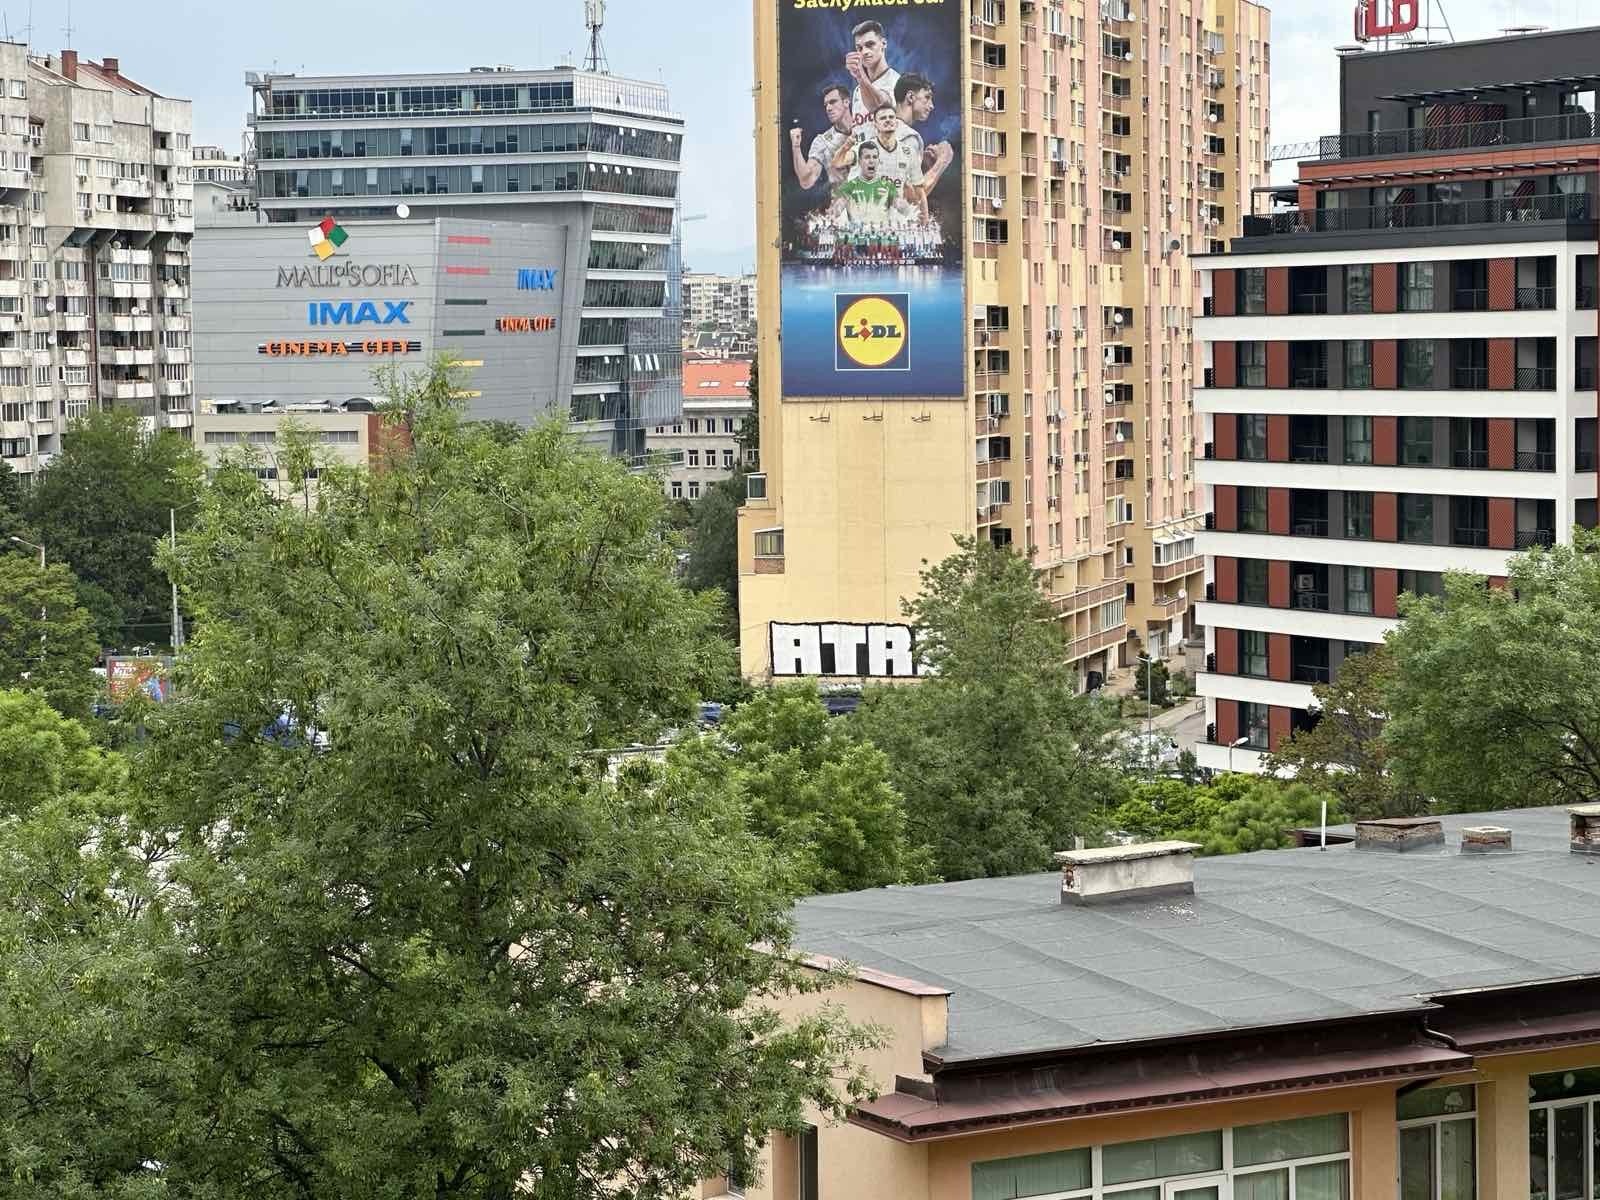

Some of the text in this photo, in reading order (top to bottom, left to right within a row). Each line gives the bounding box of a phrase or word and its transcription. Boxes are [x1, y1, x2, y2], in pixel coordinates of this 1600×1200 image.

[276, 264, 341, 288] MALL
[348, 264, 419, 288] SOFIA
[517, 269, 556, 290] IMAX
[308, 301, 411, 325] IMAX
[267, 339, 410, 357] CINEMA CITY
